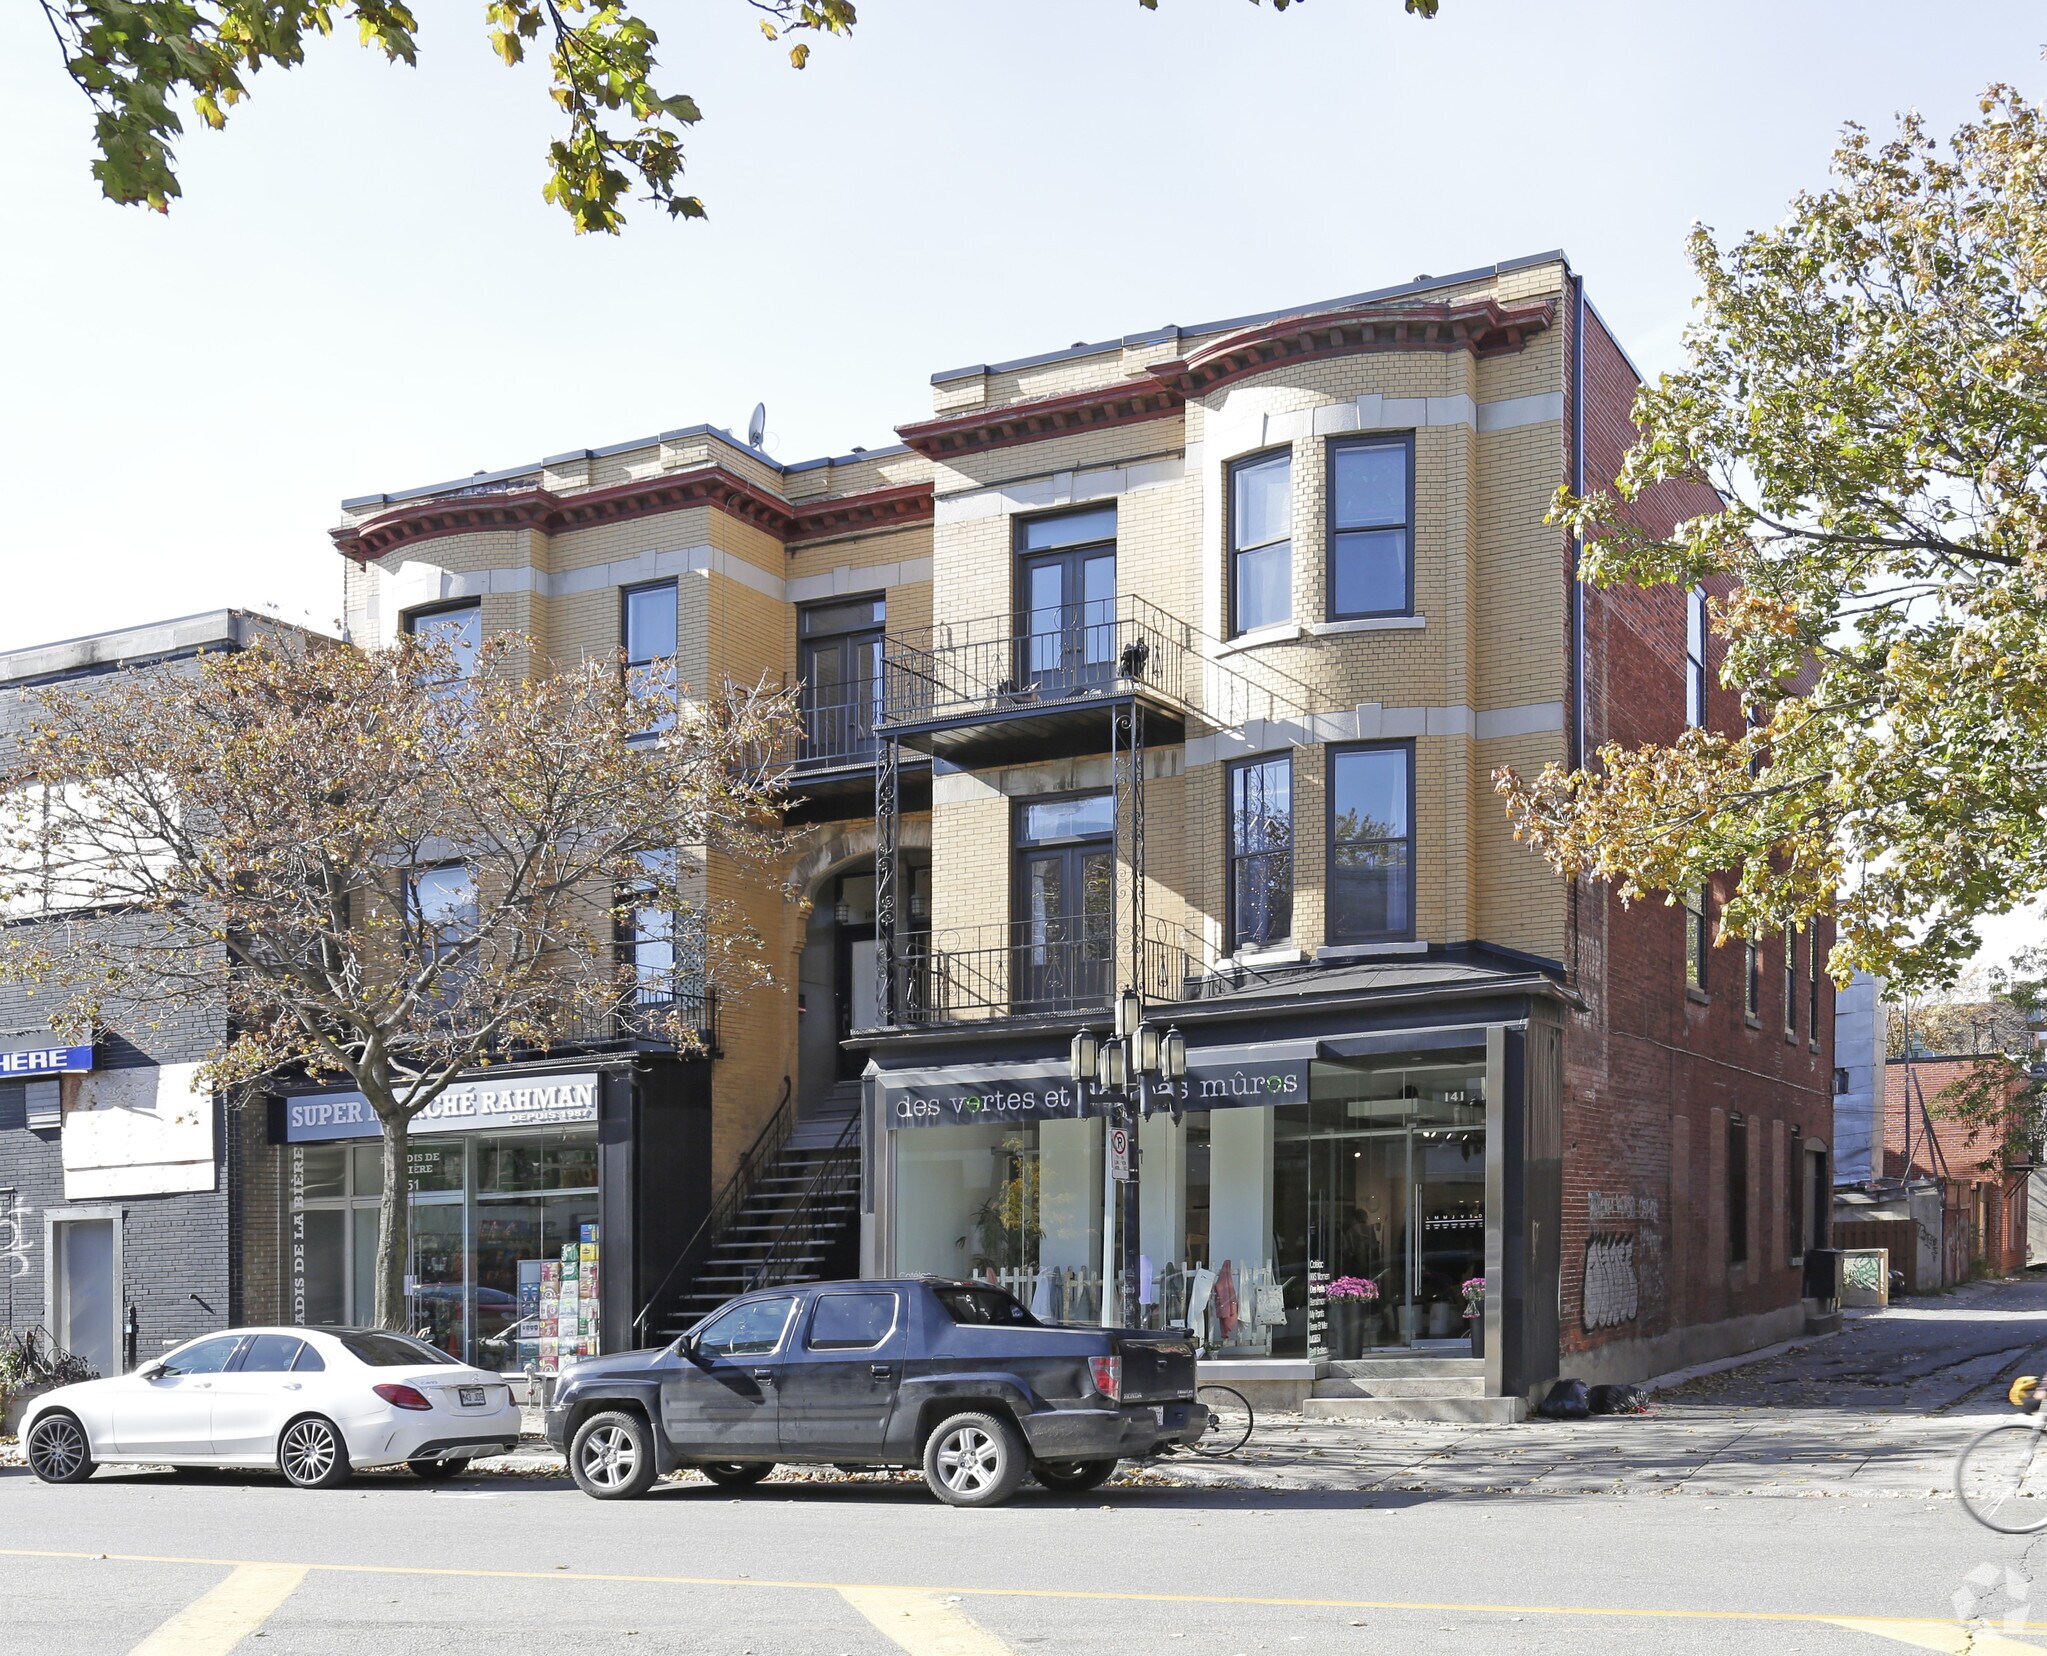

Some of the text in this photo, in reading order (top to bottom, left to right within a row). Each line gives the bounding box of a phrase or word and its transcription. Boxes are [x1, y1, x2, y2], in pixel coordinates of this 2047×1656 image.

[292, 1101, 363, 1127] SUPER
[480, 1083, 596, 1114] RAHMAN
[896, 1095, 941, 1118] des
[949, 1089, 1036, 1114] vertes
[1044, 1087, 1071, 1108] et
[1444, 1091, 1464, 1102] 141
[510, 1108, 591, 1123] DEPUIS 1987
[408, 1163, 433, 1174] IÈRE
[425, 1152, 440, 1162] DE
[291, 1147, 304, 1208] BIÈRE
[294, 1213, 305, 1240] LA
[294, 1244, 305, 1272] DE
